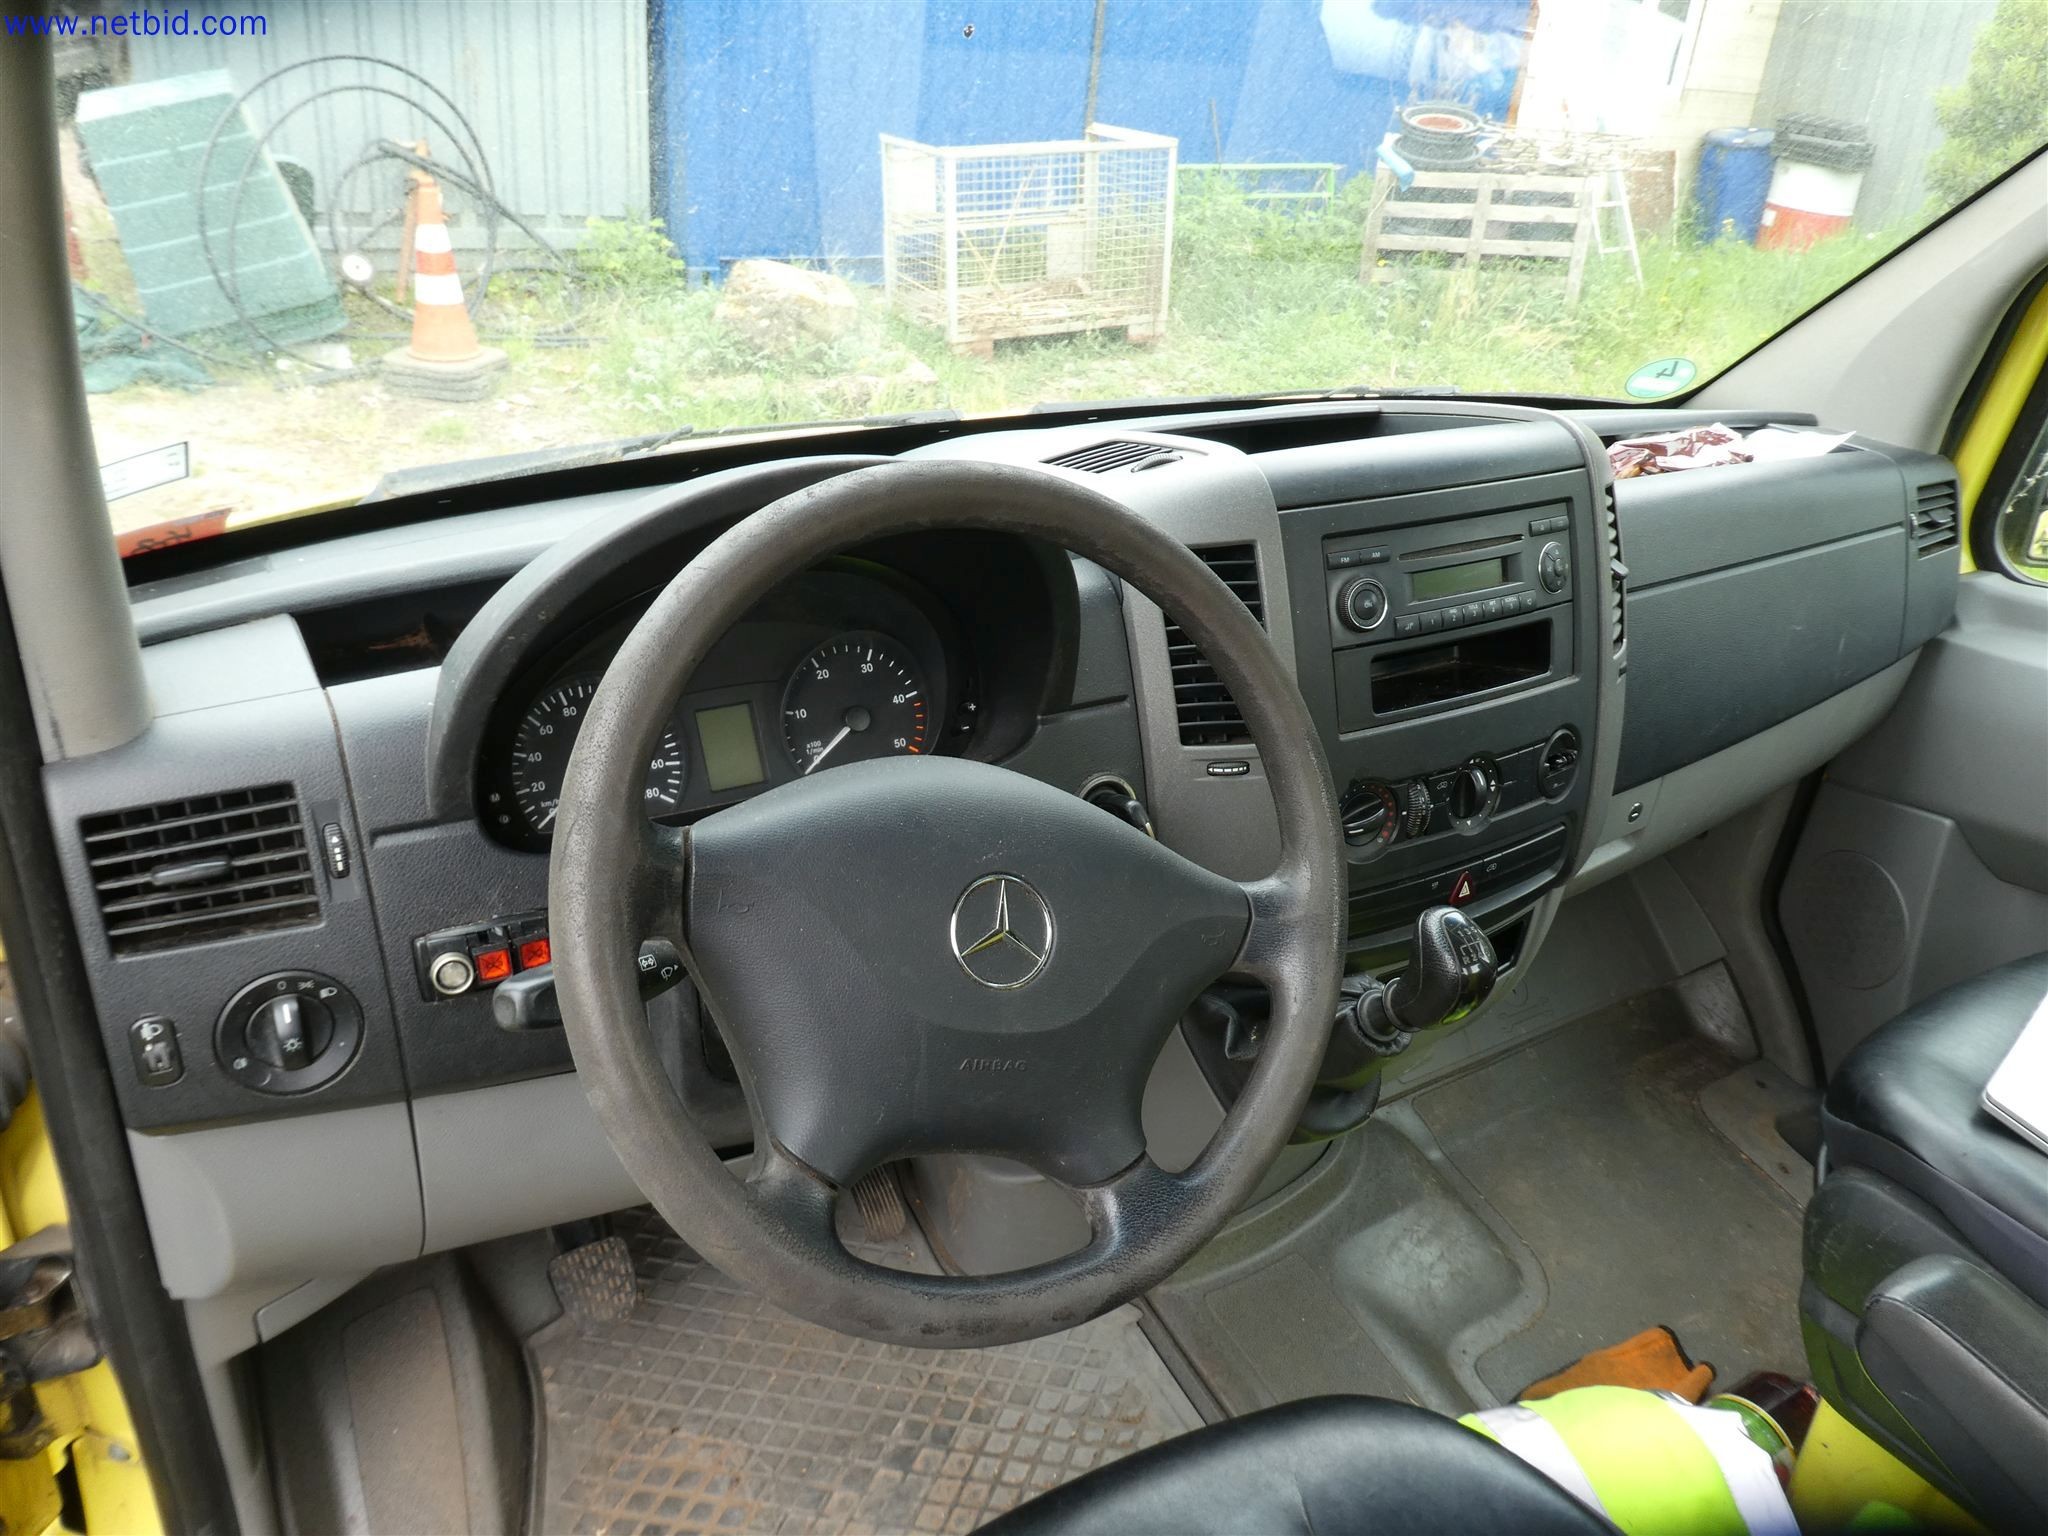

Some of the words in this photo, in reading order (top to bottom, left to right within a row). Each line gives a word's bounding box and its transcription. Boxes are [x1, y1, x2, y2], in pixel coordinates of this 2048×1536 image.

[861, 662, 873, 673] 30
[816, 669, 830, 680] 20
[892, 694, 905, 705] 40
[562, 706, 577, 717] 80
[795, 708, 807, 719] 10
[539, 725, 554, 735] 60
[894, 738, 907, 748] 50
[527, 752, 542, 763] 40
[651, 759, 664, 770] 60
[531, 781, 546, 793] 20
[959, 1058, 1026, 1071] AIRBAG
